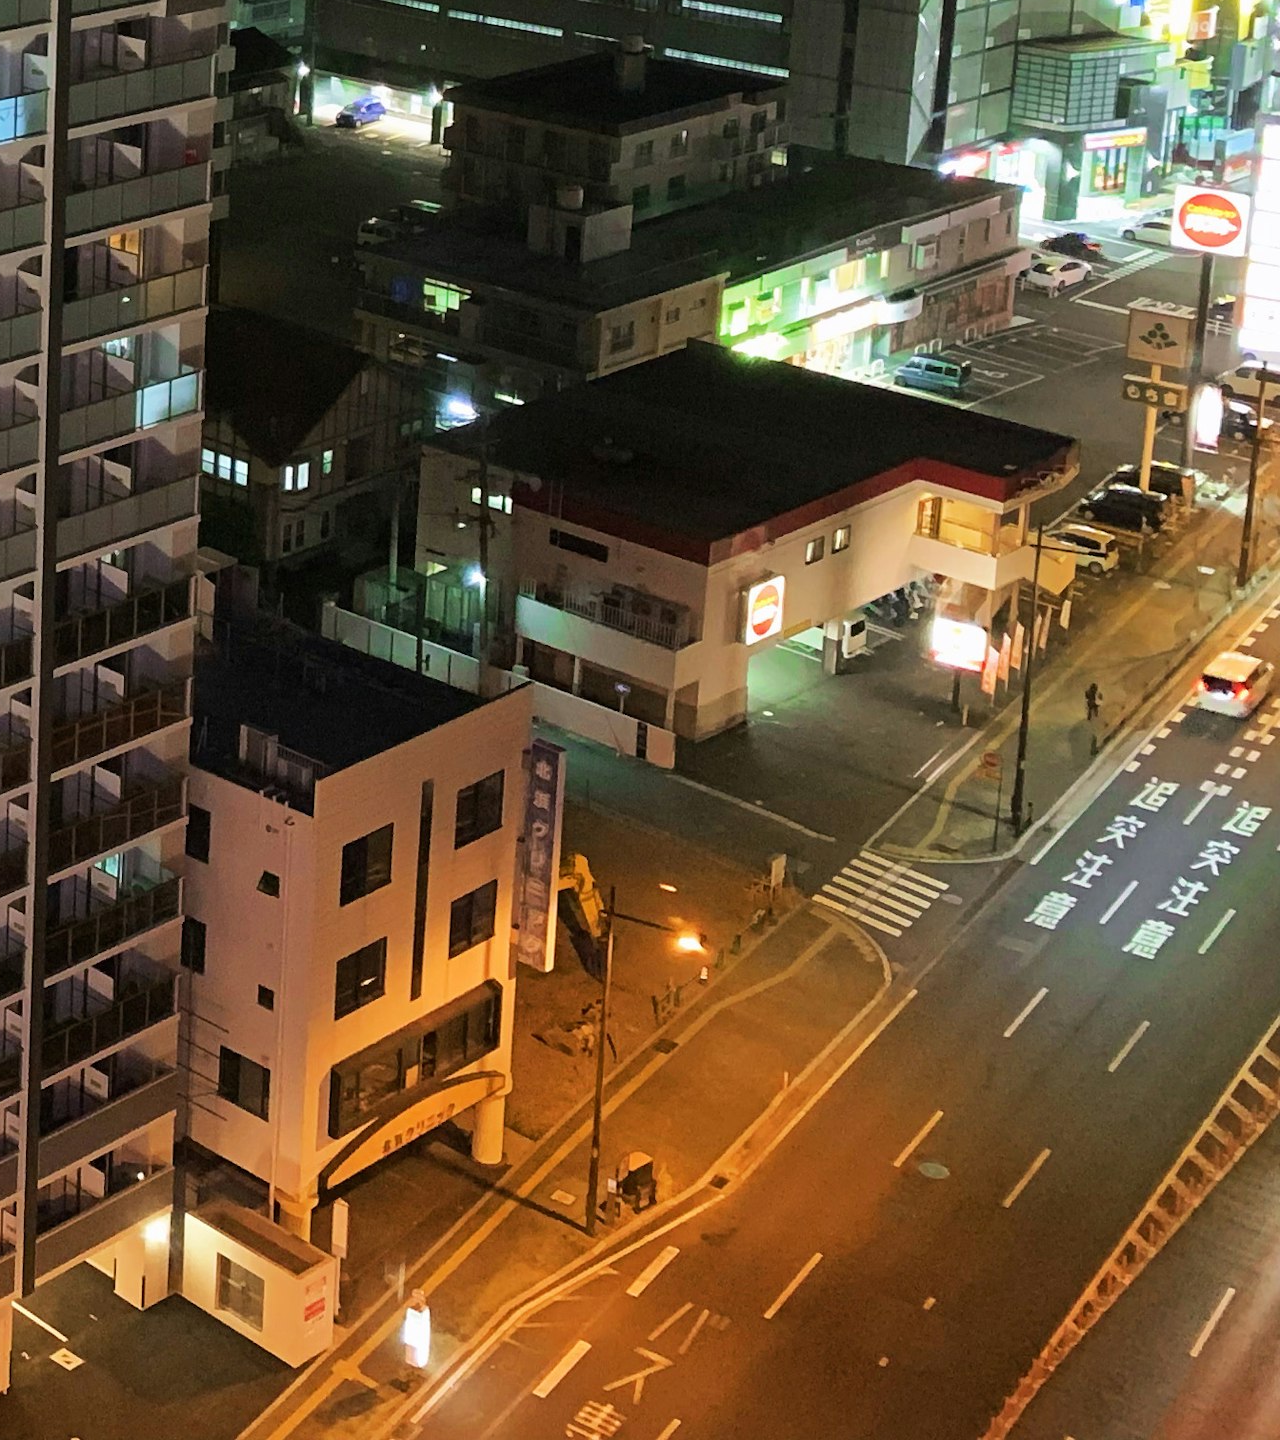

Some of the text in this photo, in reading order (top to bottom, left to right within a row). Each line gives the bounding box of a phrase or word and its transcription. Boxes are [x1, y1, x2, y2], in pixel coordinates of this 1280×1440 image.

[1023, 776, 1181, 931] 追突注意
[1121, 800, 1273, 960] 追突注意
